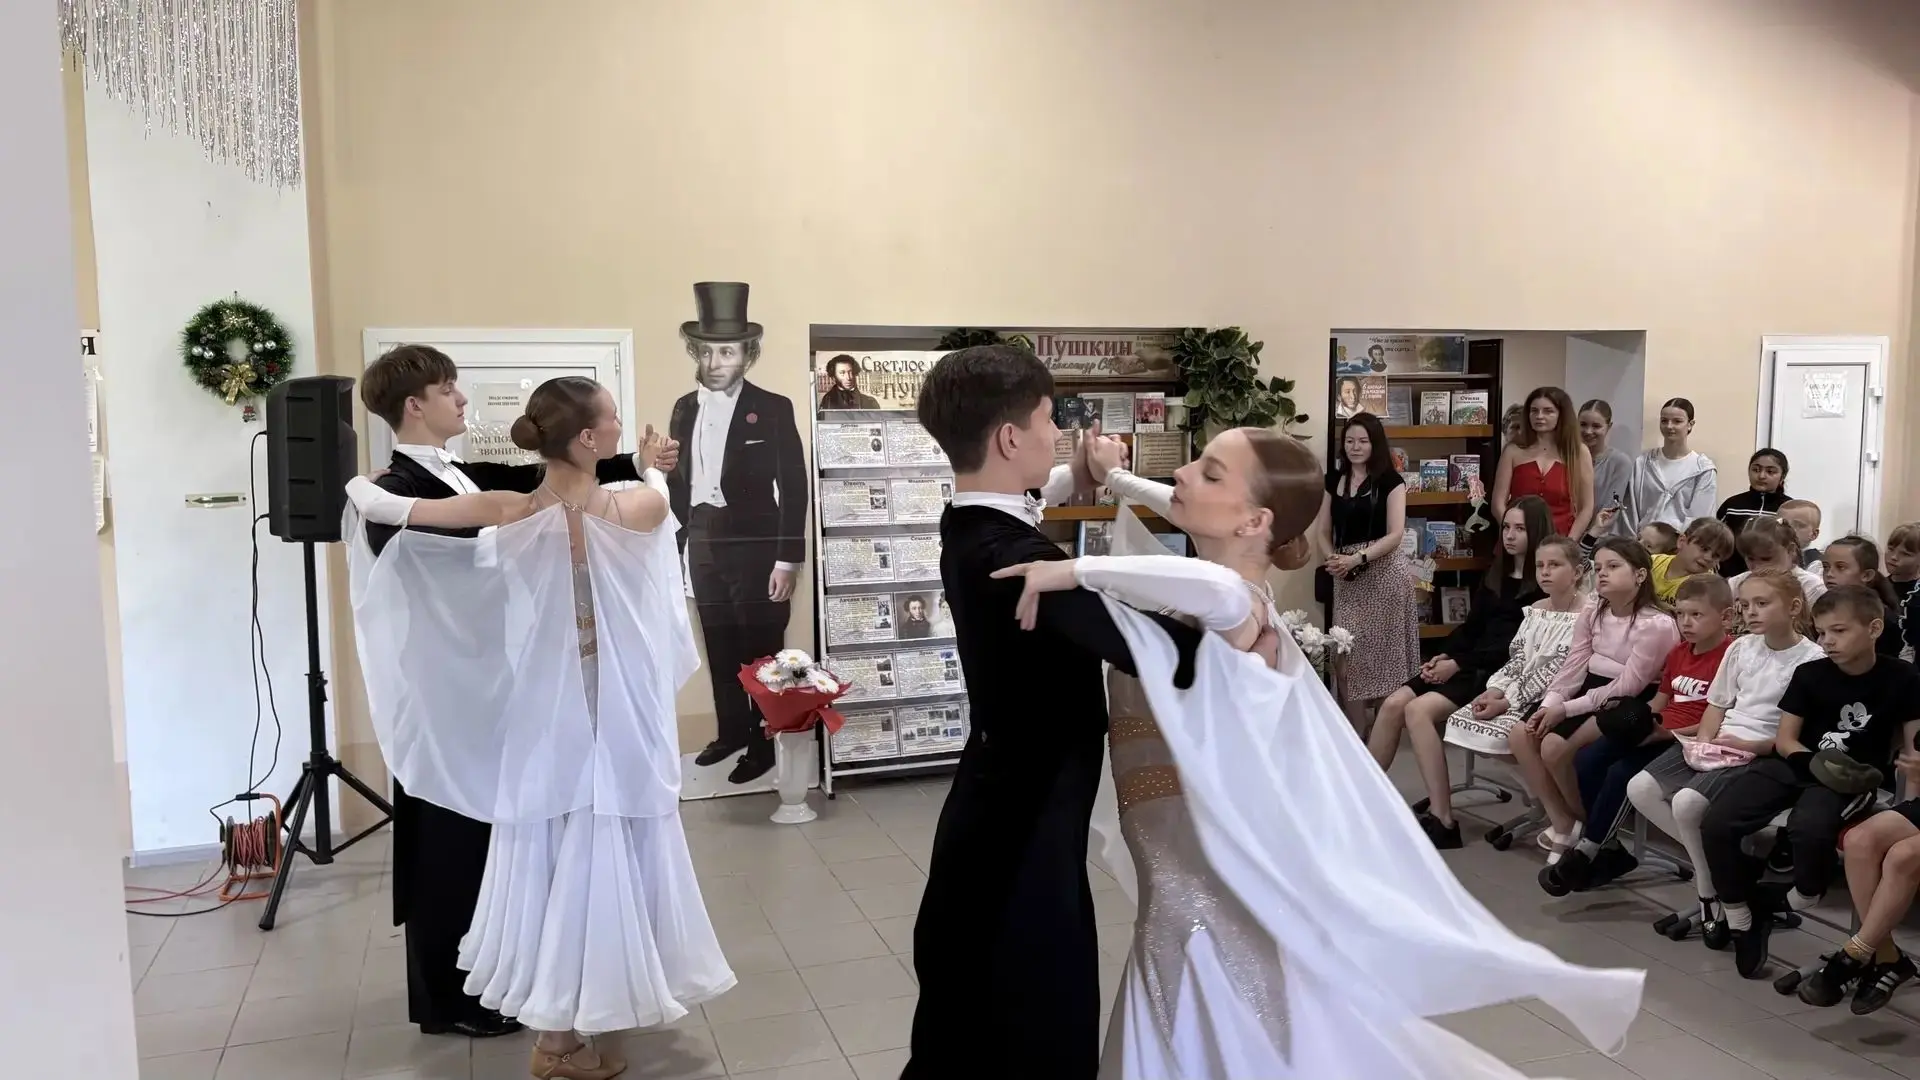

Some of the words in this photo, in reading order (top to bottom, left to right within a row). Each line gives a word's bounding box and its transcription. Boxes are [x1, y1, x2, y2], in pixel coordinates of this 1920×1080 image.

[1037, 335, 1133, 361] Пушкин
[861, 356, 925, 373] Светлое
[1671, 675, 1709, 698] NIKE
